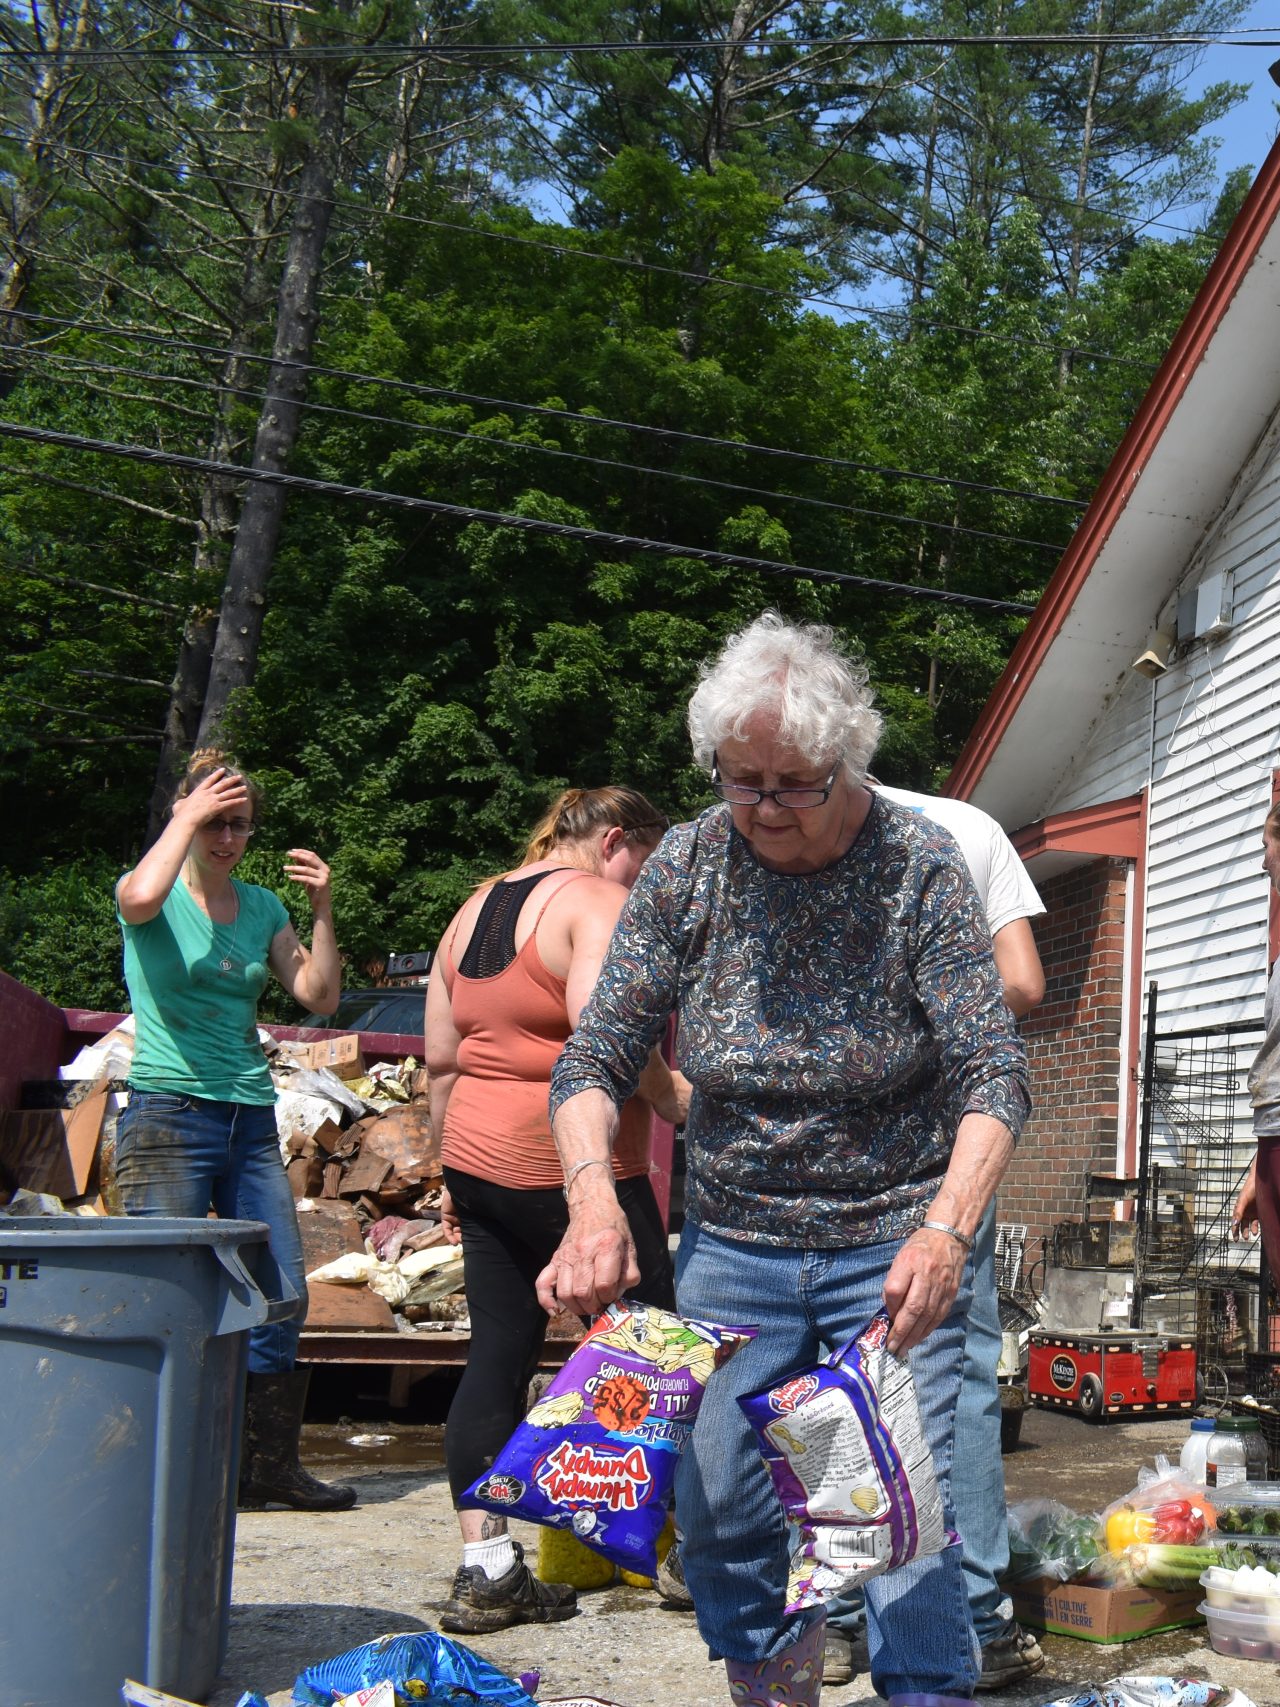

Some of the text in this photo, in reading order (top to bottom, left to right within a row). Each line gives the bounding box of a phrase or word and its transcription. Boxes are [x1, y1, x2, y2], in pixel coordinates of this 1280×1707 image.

[0, 1258, 39, 1280] TE
[599, 1362, 626, 1382] CHIPS
[659, 1378, 690, 1392] FLAVORED
[665, 1394, 691, 1412] ALL
[551, 1444, 649, 1482] Dumpty
[488, 1484, 510, 1498] HD
[542, 1468, 638, 1510] Humpty
[1059, 1599, 1088, 1615] CULTIVÉ
[1060, 1613, 1095, 1629] EN SERRE
